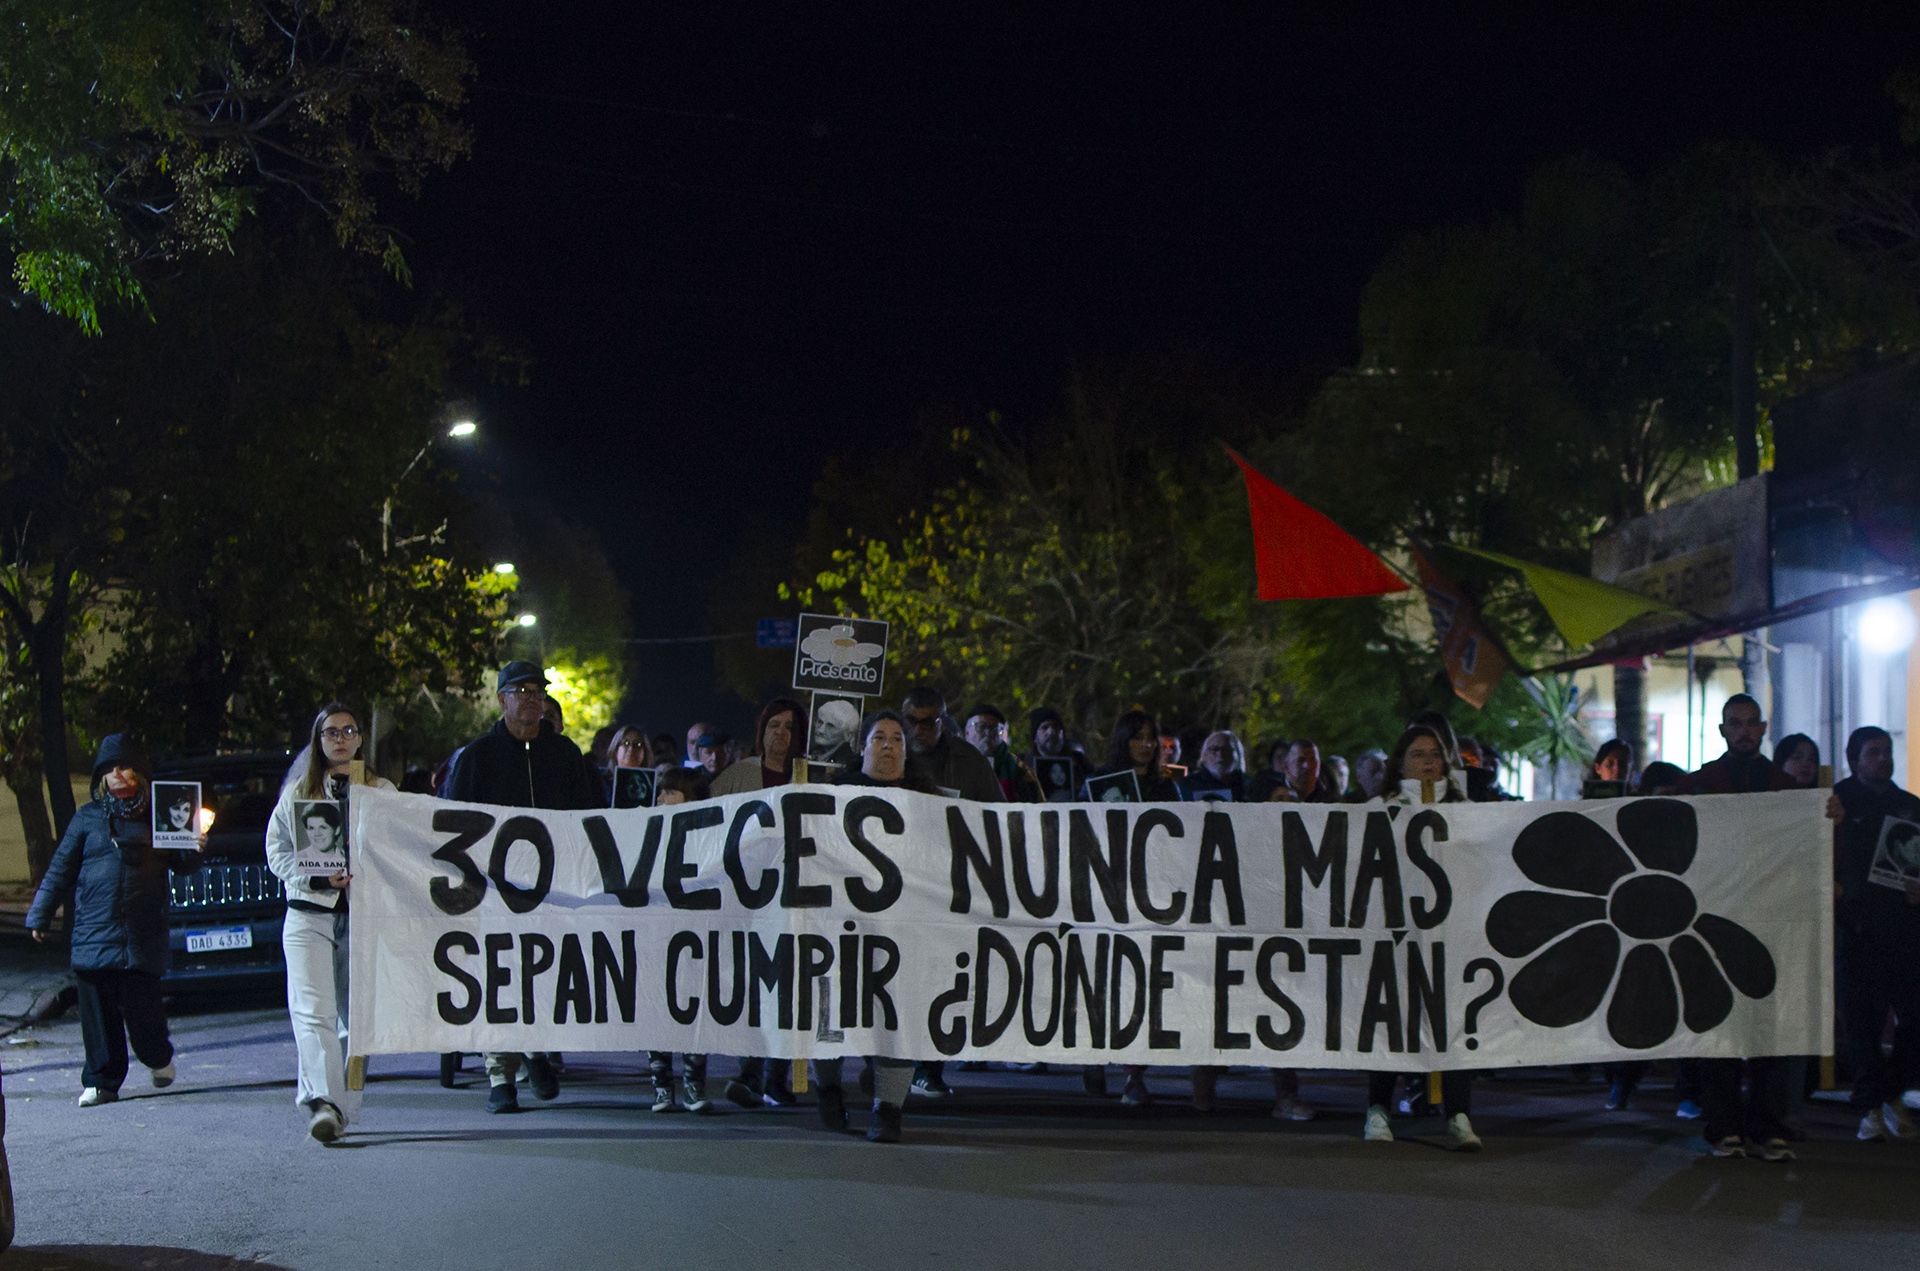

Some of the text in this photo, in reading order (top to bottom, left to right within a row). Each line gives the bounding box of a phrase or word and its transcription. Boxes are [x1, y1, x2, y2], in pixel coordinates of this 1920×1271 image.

[800, 657, 877, 683] Presente
[429, 793, 1452, 929] 30 VECES NUNCA MÁS
[434, 930, 635, 1025] SEPAN
[928, 923, 1185, 1055] ¿DÓNDE
[1214, 930, 1504, 1053] ESTÁN?
